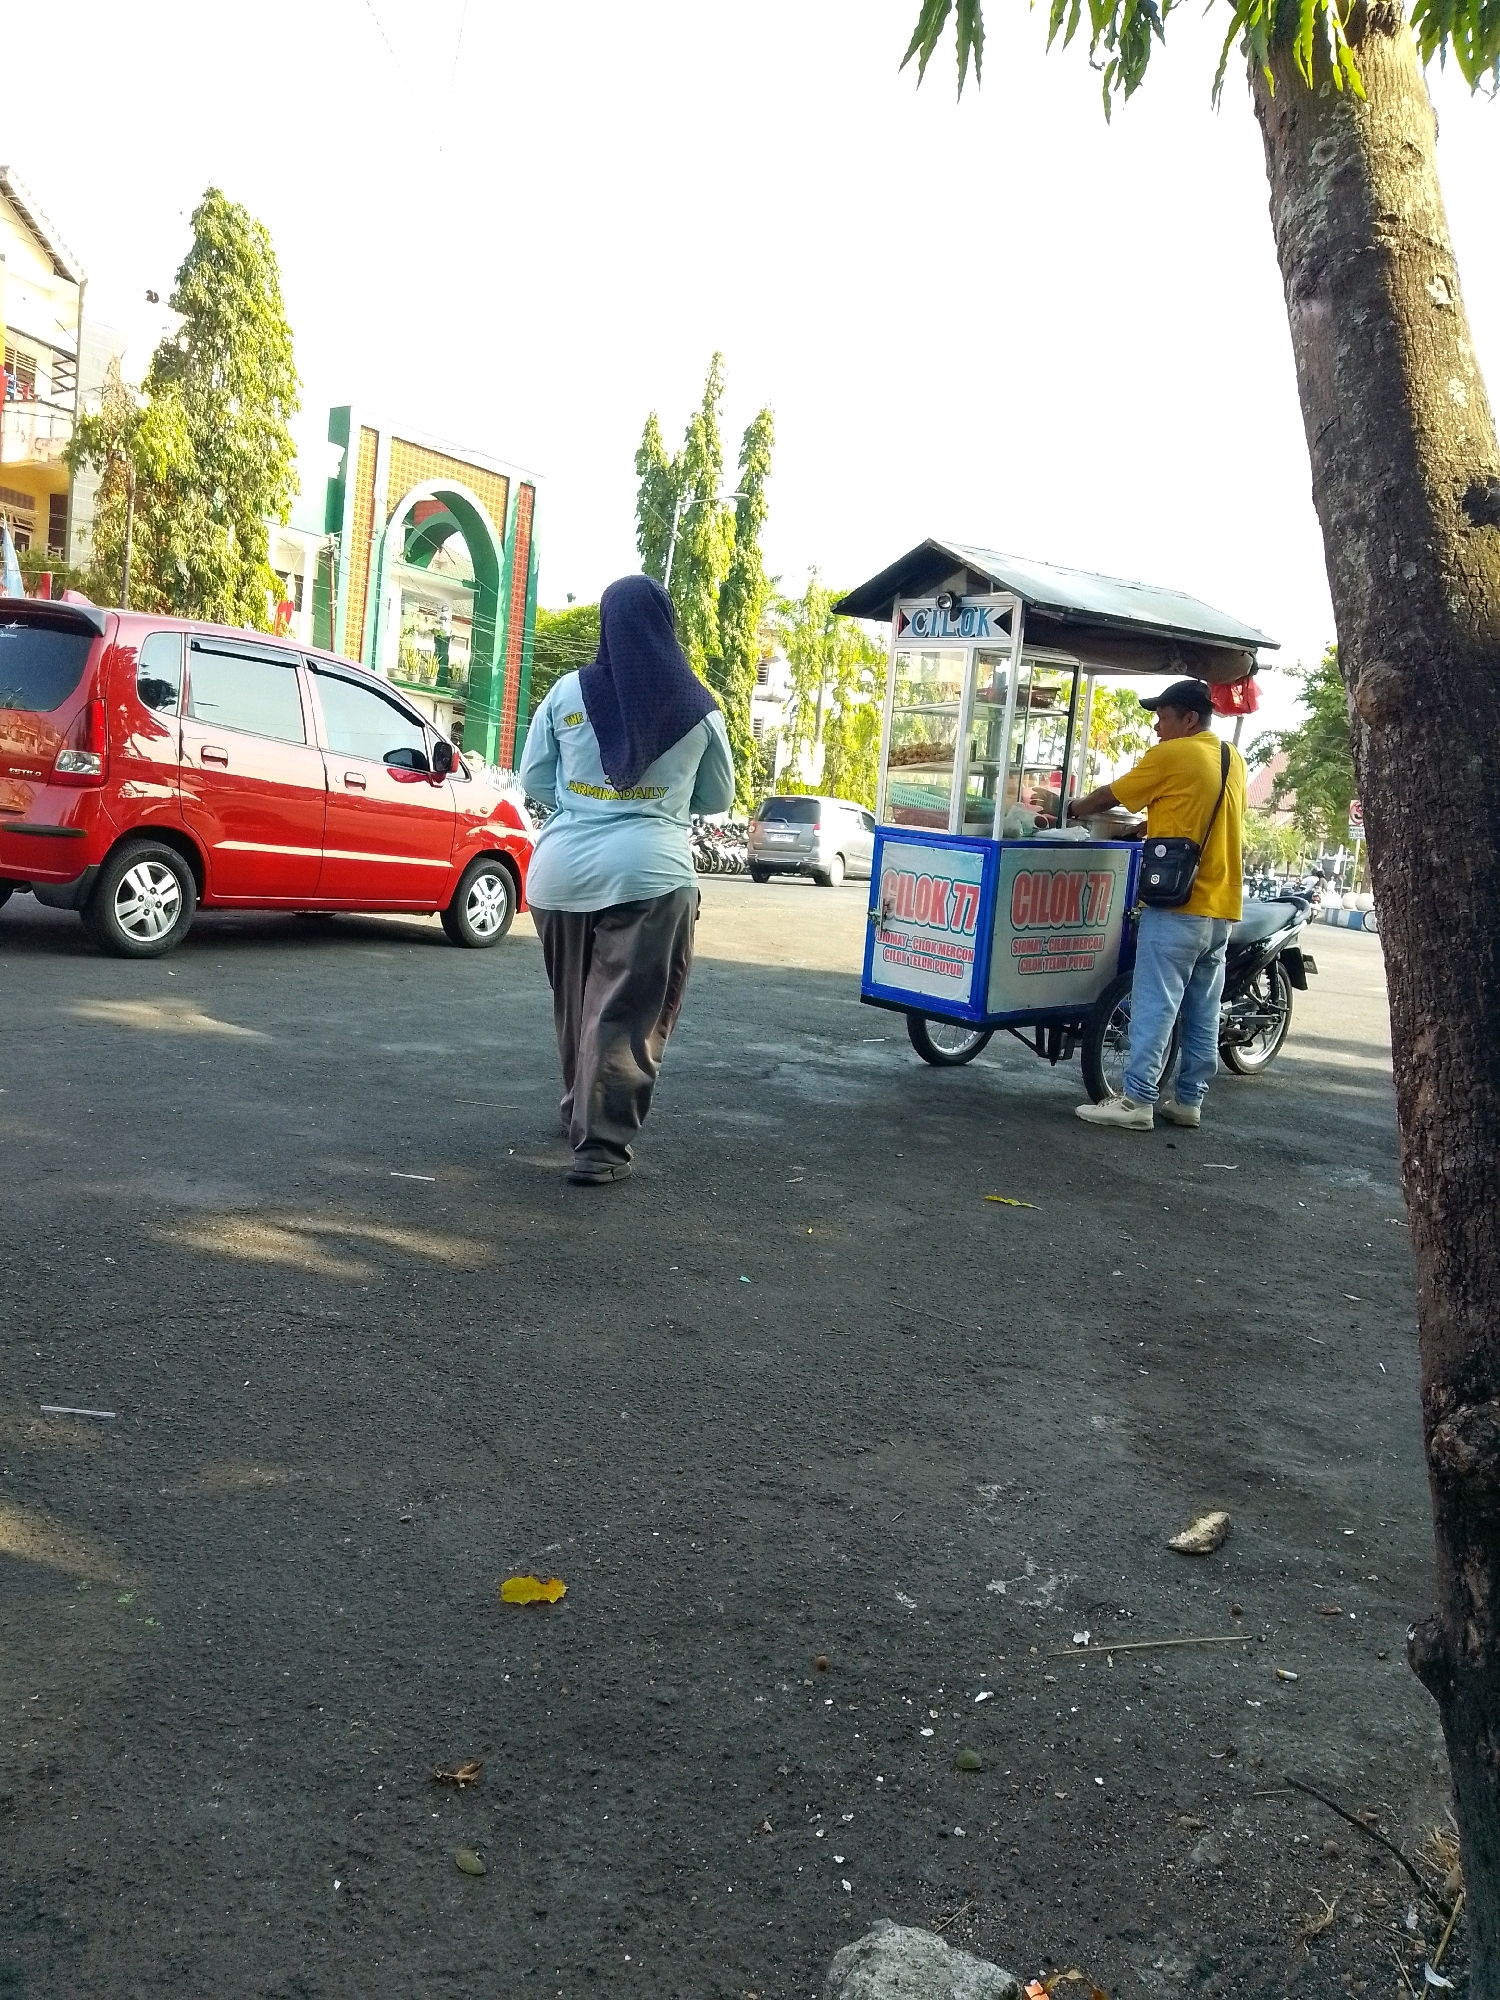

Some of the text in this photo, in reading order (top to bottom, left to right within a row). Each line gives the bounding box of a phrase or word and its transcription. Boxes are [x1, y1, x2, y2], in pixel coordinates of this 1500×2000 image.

[911, 608, 990, 637] CILOK
[564, 712, 584, 727] THE
[881, 868, 980, 933] CILOK 77
[1012, 871, 1114, 928] CILOK 77
[912, 938, 938, 954] CILOK
[938, 943, 975, 962] MERCON
[1048, 936, 1072, 952] CILOK
[1073, 934, 1104, 951] MERCON
[884, 948, 963, 976] CILOK TELUR PUYUH
[1020, 957, 1043, 973] CILOK
[1068, 953, 1093, 970] PUYUH
